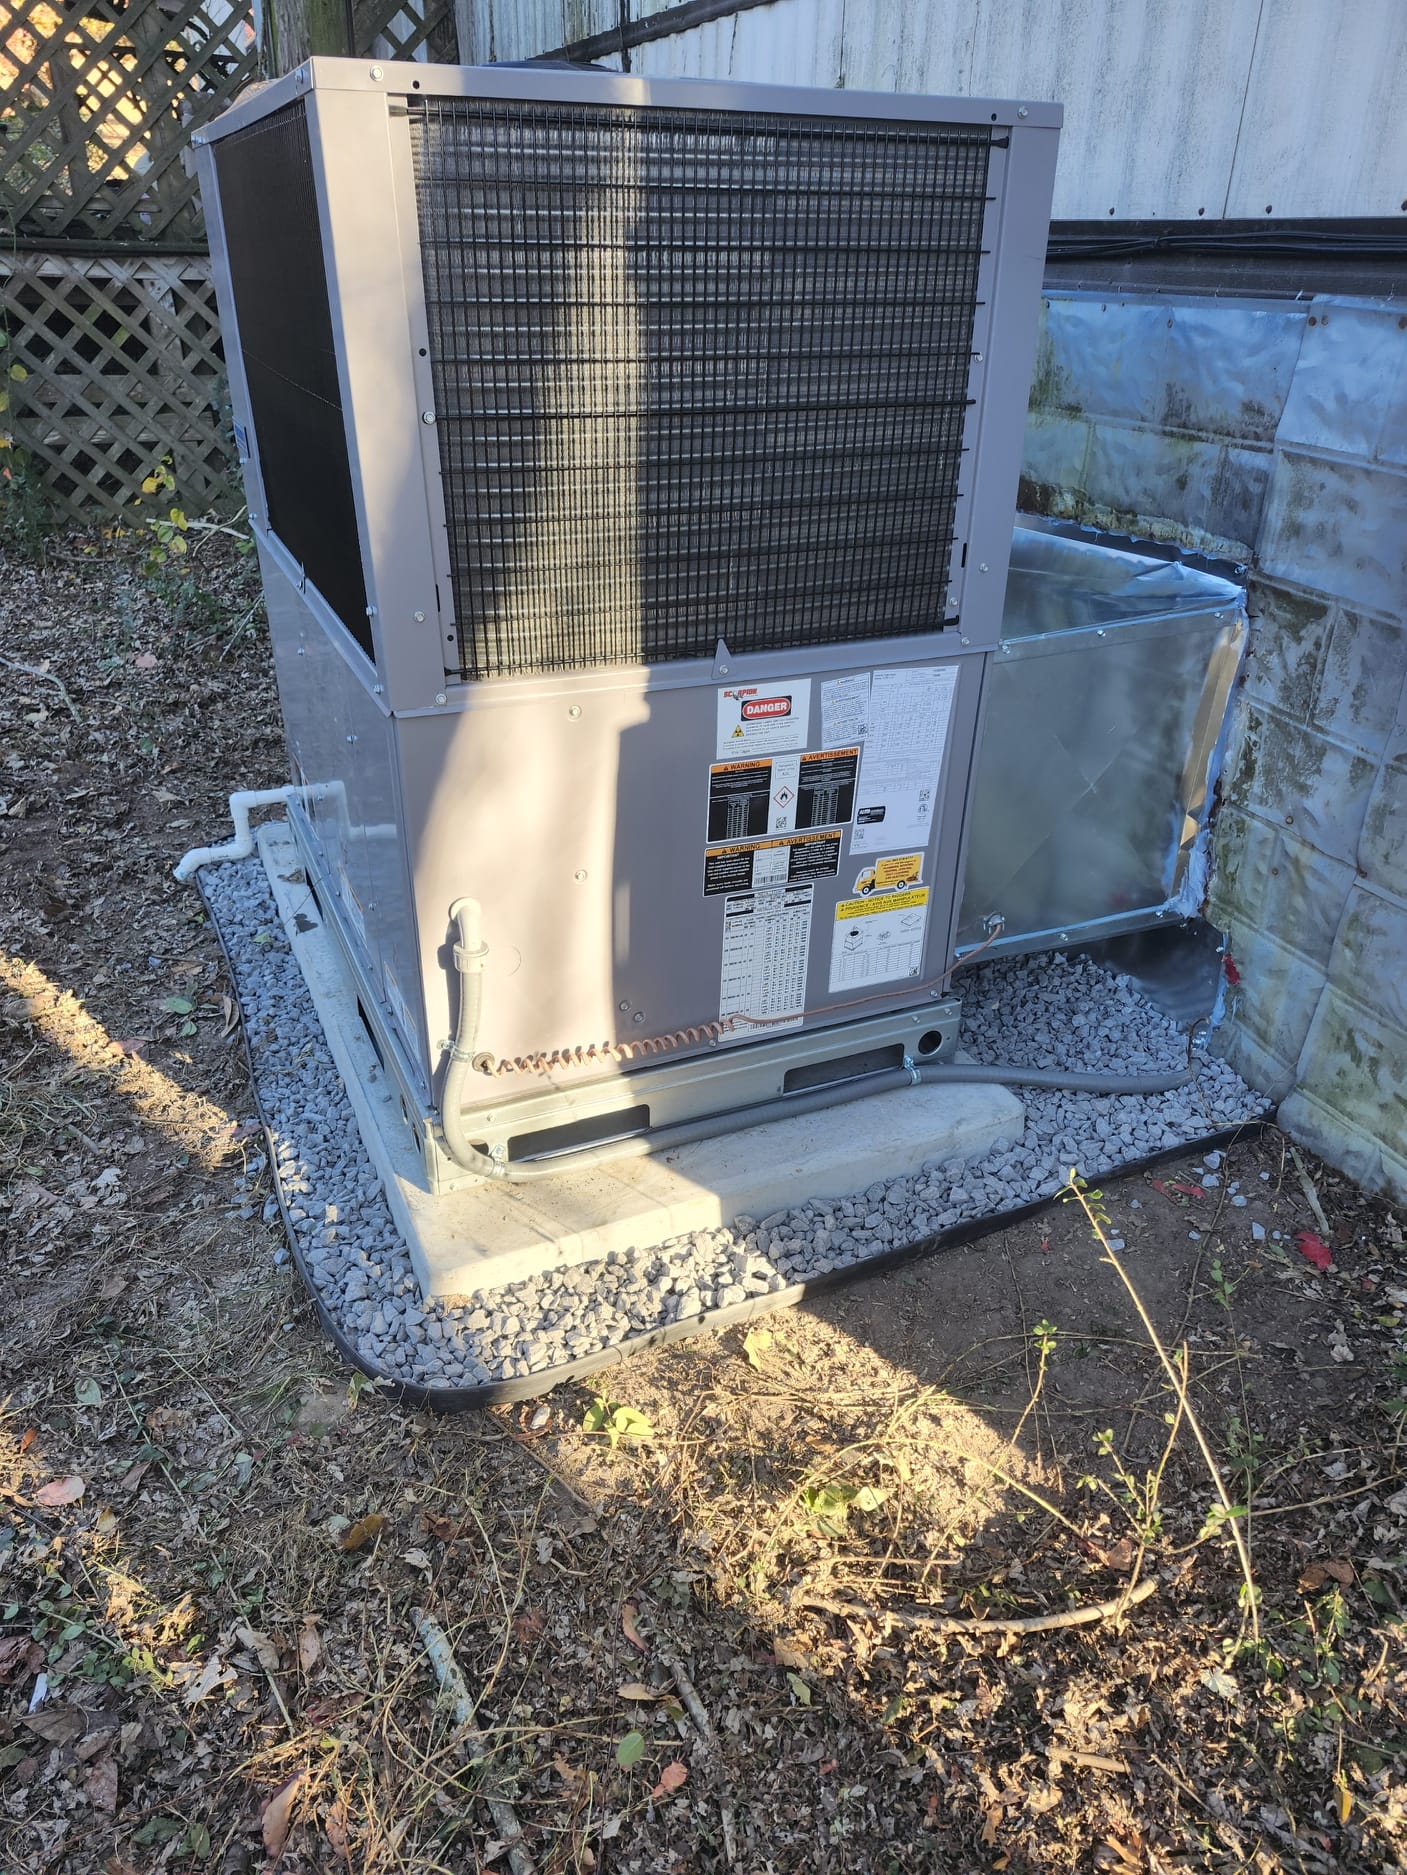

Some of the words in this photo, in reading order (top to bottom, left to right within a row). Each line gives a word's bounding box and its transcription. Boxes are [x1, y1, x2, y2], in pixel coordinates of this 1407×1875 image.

[746, 702, 787, 715] DANGER
[808, 749, 858, 760] AVERTISSEMENT
[730, 761, 761, 770] WARNING
[786, 832, 837, 845] AVERTISSEMENT
[729, 844, 761, 853] WARNING
